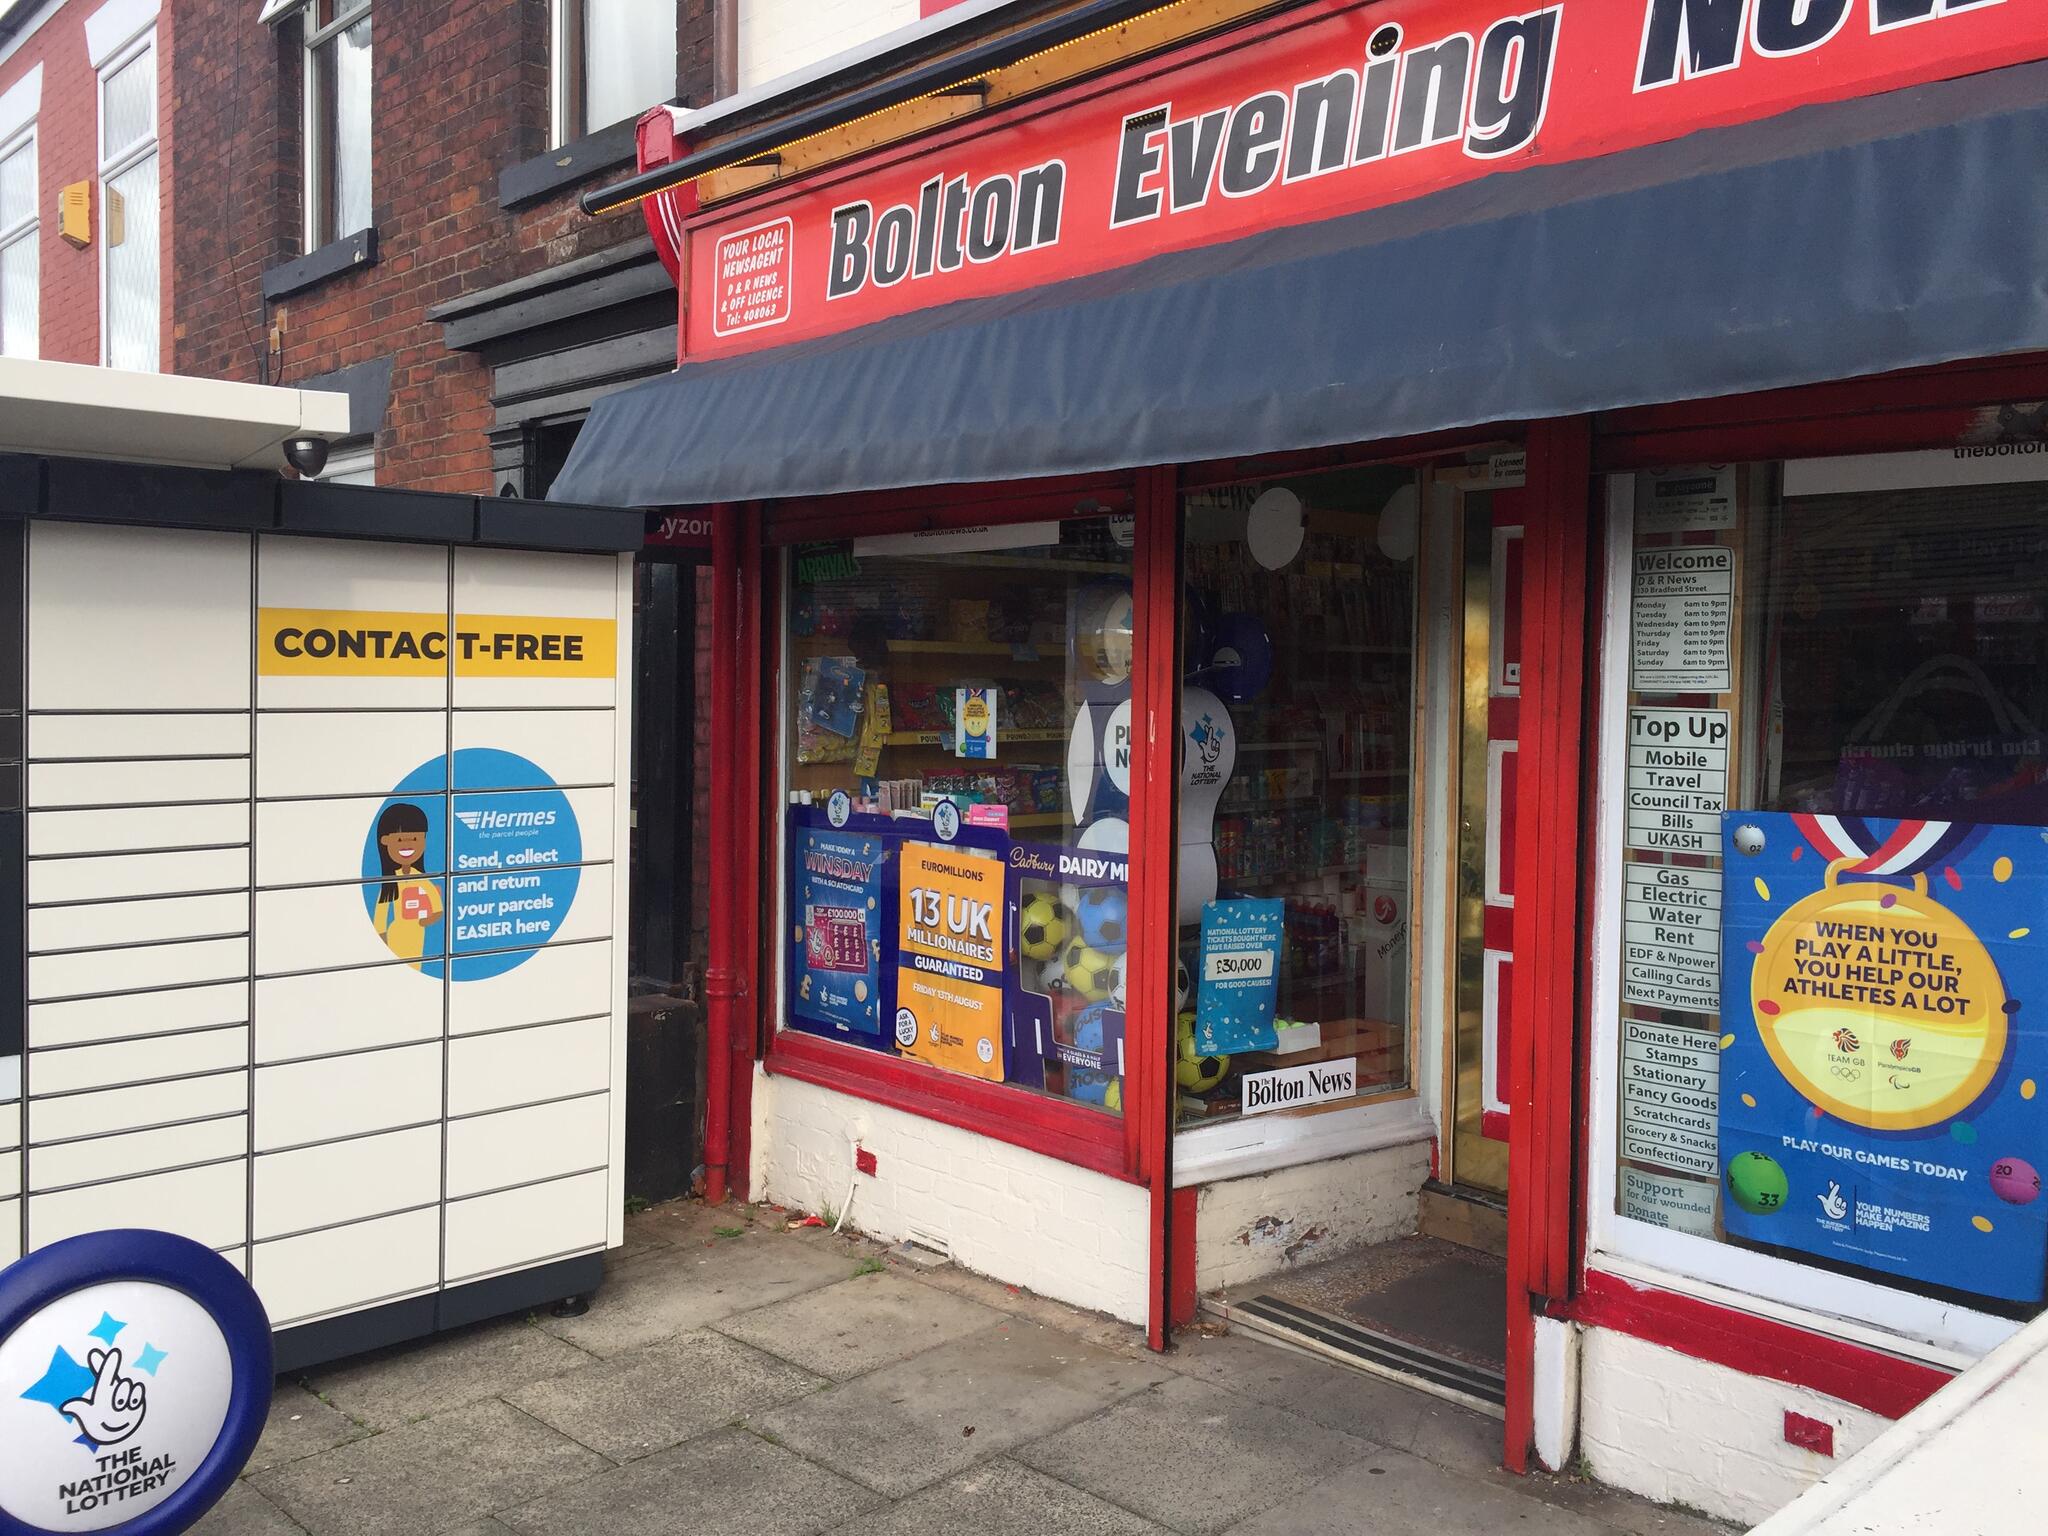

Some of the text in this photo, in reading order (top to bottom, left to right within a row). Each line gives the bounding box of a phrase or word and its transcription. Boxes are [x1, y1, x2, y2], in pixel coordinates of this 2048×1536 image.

[826, 158, 1067, 302] Bolton
[1109, 4, 1563, 229] Evening
[723, 228, 784, 261] YOUR LOCAL
[722, 247, 784, 279] NEWSAGENT
[727, 271, 778, 297] D & R NEWS
[721, 285, 784, 313] & OFF LICENCE
[726, 303, 776, 326] Tel: 408063
[1638, 552, 1728, 571] Welcome
[1638, 574, 1697, 586] D & R News
[1650, 585, 1683, 594] Bradford
[1636, 601, 1667, 610] Monday
[1711, 600, 1727, 609] 9pm
[1636, 611, 1668, 619] Tuesday
[1710, 610, 1727, 619] 9pm
[1636, 621, 1679, 629] Wednesday
[1710, 620, 1726, 629] 9pm
[1636, 630, 1671, 638] Thursday
[1709, 630, 1725, 638] 9pm
[273, 627, 584, 662] CONTACT-FREE
[1636, 640, 1660, 648] Friday
[1709, 639, 1725, 648] 9pm
[1636, 649, 1670, 658] Saturday
[1708, 649, 1725, 658] 9pm
[1637, 659, 1664, 667] Sunday
[1707, 659, 1725, 667] 9pm
[1631, 714, 1727, 745] Top Up
[1645, 750, 1708, 767] Mobile
[1190, 771, 1222, 780] NATIONAL
[1645, 771, 1701, 789] Travel
[1630, 792, 1722, 812] Council Tax
[480, 810, 557, 829] Hermes
[1661, 813, 1694, 830] Bills
[479, 829, 540, 839] the parcel people
[1647, 831, 1703, 849] UKASH
[458, 848, 559, 869] Send, collect
[803, 849, 874, 883] WINSDAY
[1009, 846, 1129, 882] Cadbury DAIRY MI
[921, 860, 984, 882] EUROMILLIONS
[1656, 869, 1690, 886] Gas
[457, 875, 541, 893] and return
[457, 893, 555, 921] your parcels
[1642, 886, 1708, 906] Electric
[909, 887, 993, 942] 13 UK
[1648, 906, 1703, 925] Water
[456, 918, 551, 941] EASIER here
[1207, 927, 1267, 936] NATIONAL LOTTERY
[1207, 933, 1277, 944] TICKETS BOUGHT HERE
[1654, 926, 1695, 946] Rent
[1815, 920, 1938, 949] WHEN YOU
[906, 926, 994, 962] MILLIONAIRES
[1206, 941, 1263, 952] HAVE RAISED OVER
[1216, 958, 1262, 975] £30,000
[1629, 947, 1716, 969] EDF & Npower
[1795, 938, 1962, 976] PLAY A LITTLE,
[914, 955, 984, 982] GUARANTEED
[1631, 966, 1712, 988] Calling Cards
[1793, 957, 1960, 994] YOU HELP OUR
[1215, 978, 1272, 990] FOR GOOD CAUSES!
[913, 983, 938, 998] FRIDAY
[954, 996, 984, 1011] AUGUST
[1627, 984, 1720, 1007] Next Payments
[1783, 977, 1971, 1016] ATHLETES A LOT
[898, 1027, 914, 1035] LUCKY
[1629, 1025, 1718, 1051] Donate Here
[1062, 1052, 1102, 1070] EVERYONE
[1645, 1047, 1699, 1068] Stamps
[1827, 1053, 1866, 1067] TEAM GB
[1247, 1068, 1352, 1108] Bolton News
[1261, 1078, 1271, 1086] The
[1632, 1064, 1707, 1090] Stationary
[1628, 1083, 1718, 1111] Fancy Goods
[1633, 1105, 1712, 1130] Scratchcards
[1626, 1124, 1717, 1151] Grocery & Snacks
[1628, 1142, 1715, 1172] Confectionary
[1782, 1135, 1969, 1182] PLAY OUR GAMES TODAY
[1995, 1164, 2013, 1176] 20
[1627, 1174, 1685, 1199] Support
[1626, 1188, 1711, 1214] for our wounded
[1757, 1191, 1780, 1207] 33
[1627, 1201, 1669, 1222] Donate
[1855, 1209, 1930, 1232] MAKE AMAZING
[1856, 1200, 1931, 1224] YOUR NUMBERS
[1855, 1218, 1893, 1232] HAPPEN
[95, 1445, 143, 1473] THE
[59, 1453, 177, 1500] NATIONAL
[66, 1469, 173, 1515] LOTTERY
